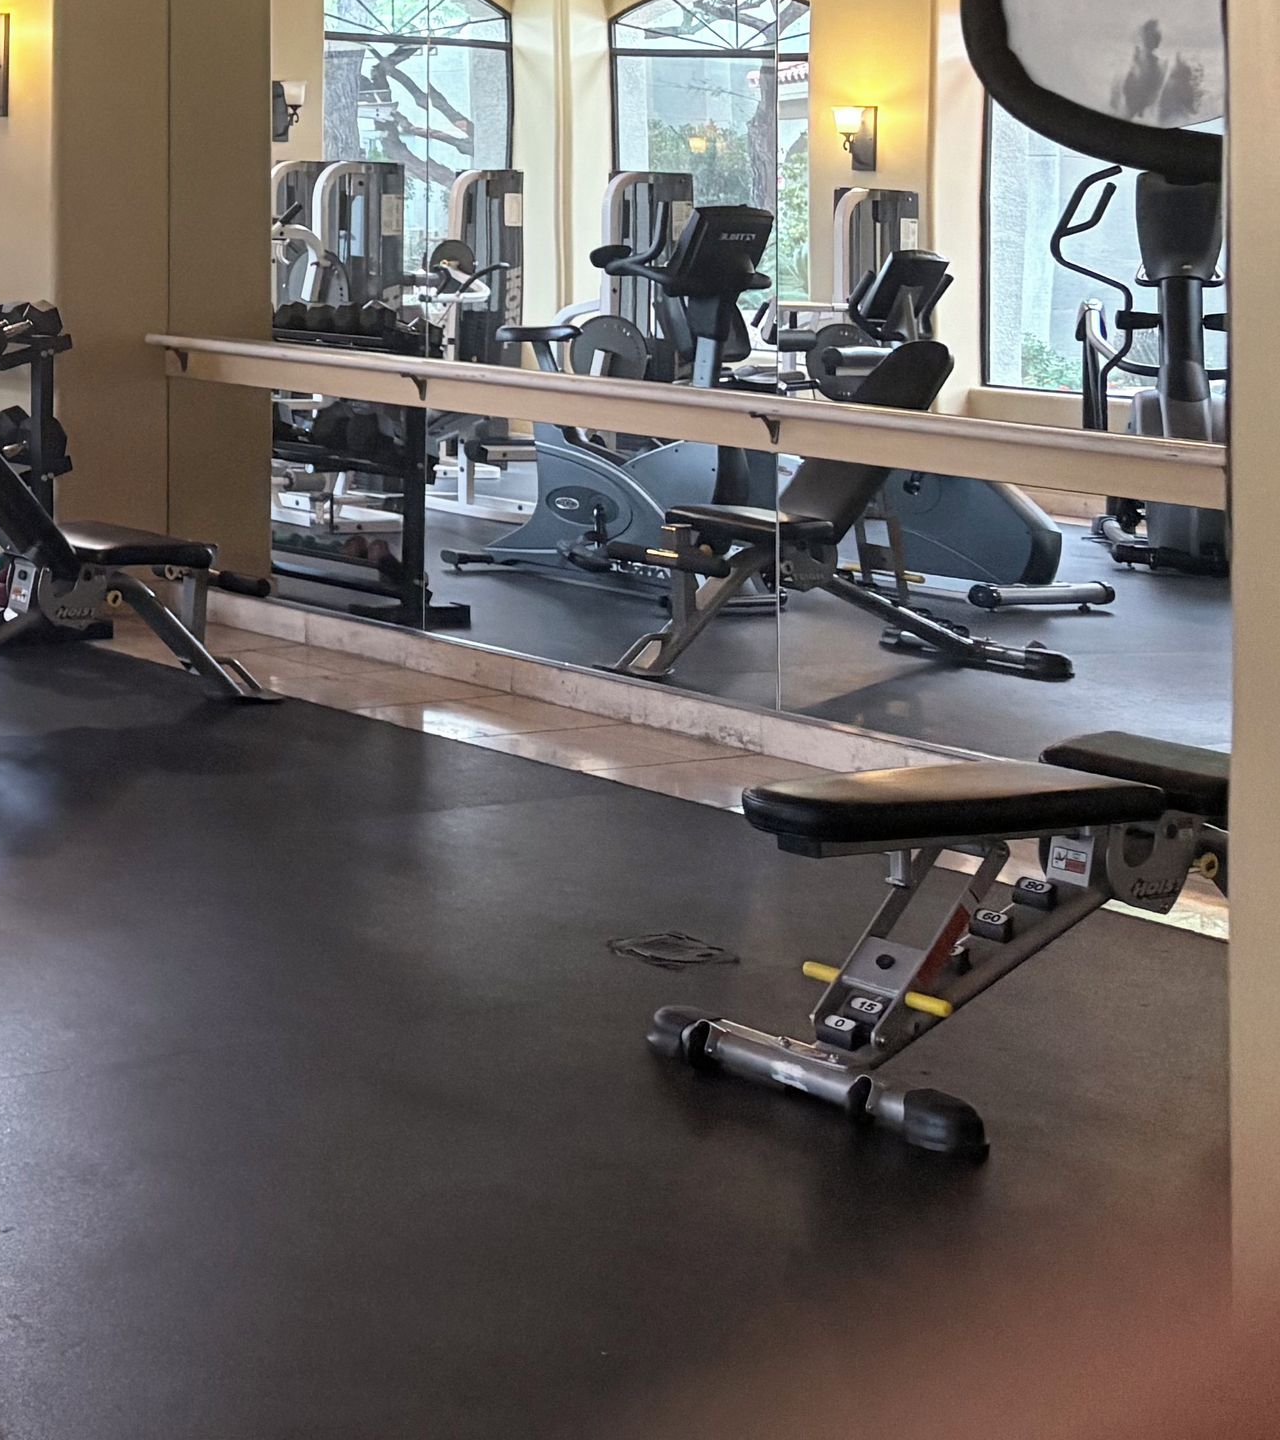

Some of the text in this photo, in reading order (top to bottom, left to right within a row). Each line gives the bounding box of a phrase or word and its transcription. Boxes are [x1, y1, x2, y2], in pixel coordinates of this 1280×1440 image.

[1024, 881, 1045, 891] 80
[982, 912, 1001, 922] 60
[859, 1001, 877, 1012] 15
[834, 1018, 845, 1028] 0
